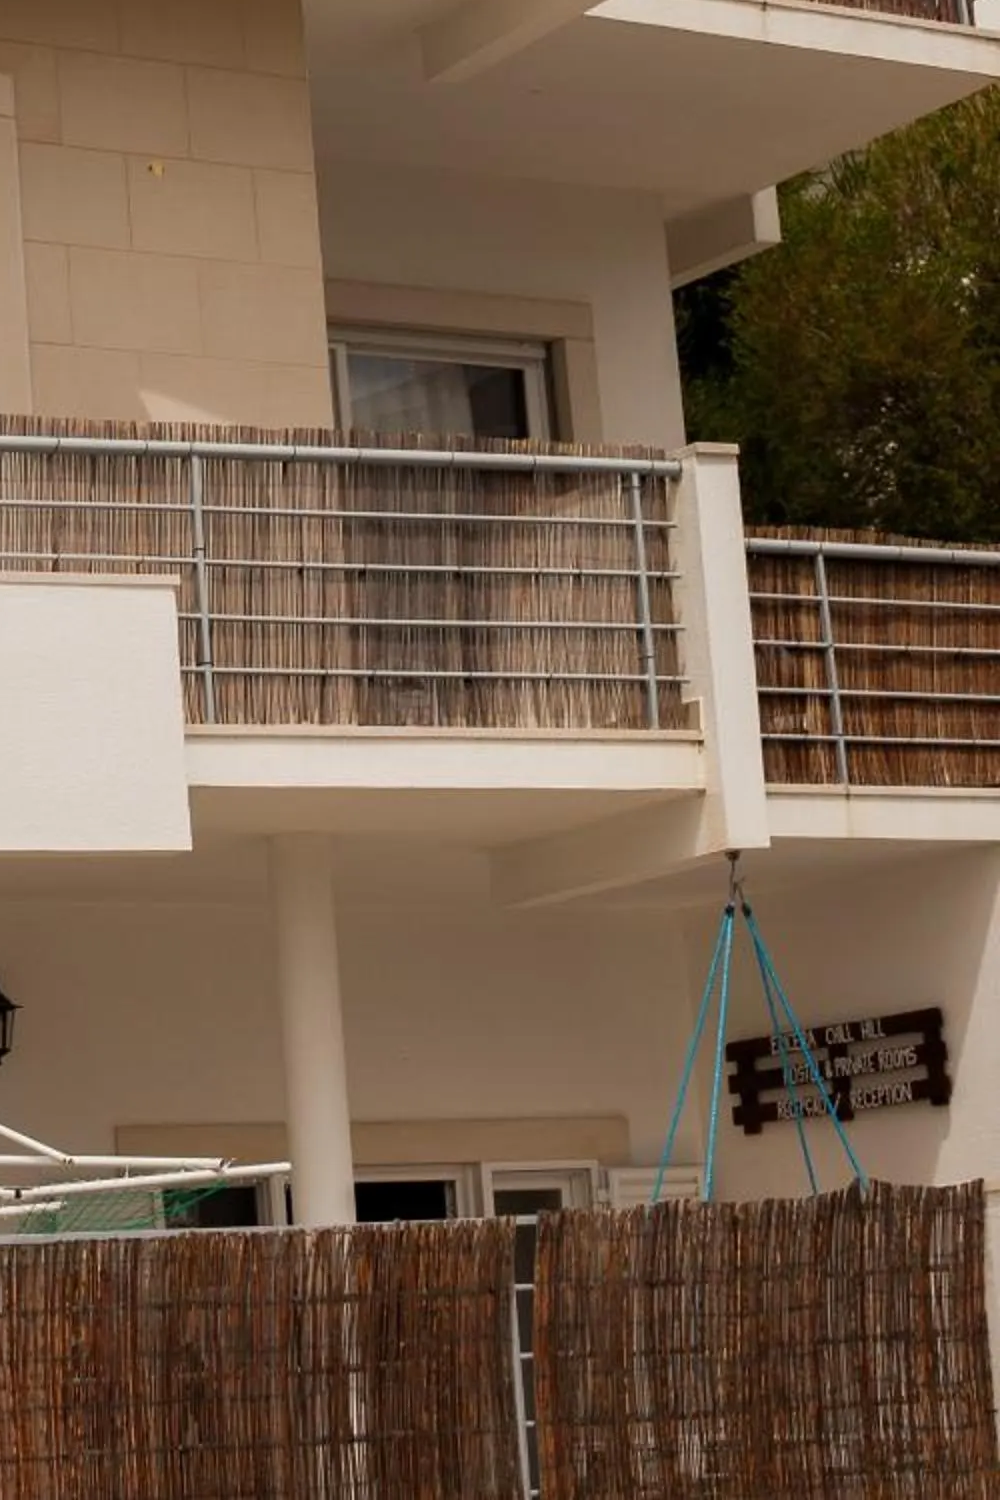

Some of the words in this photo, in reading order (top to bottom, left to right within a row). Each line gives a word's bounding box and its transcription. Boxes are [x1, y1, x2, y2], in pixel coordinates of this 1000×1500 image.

[861, 1018, 887, 1041] HILL
[834, 1051, 875, 1077] PRIVATE
[877, 1046, 918, 1069] ROOMS
[850, 1082, 913, 1109] RECEPTION
